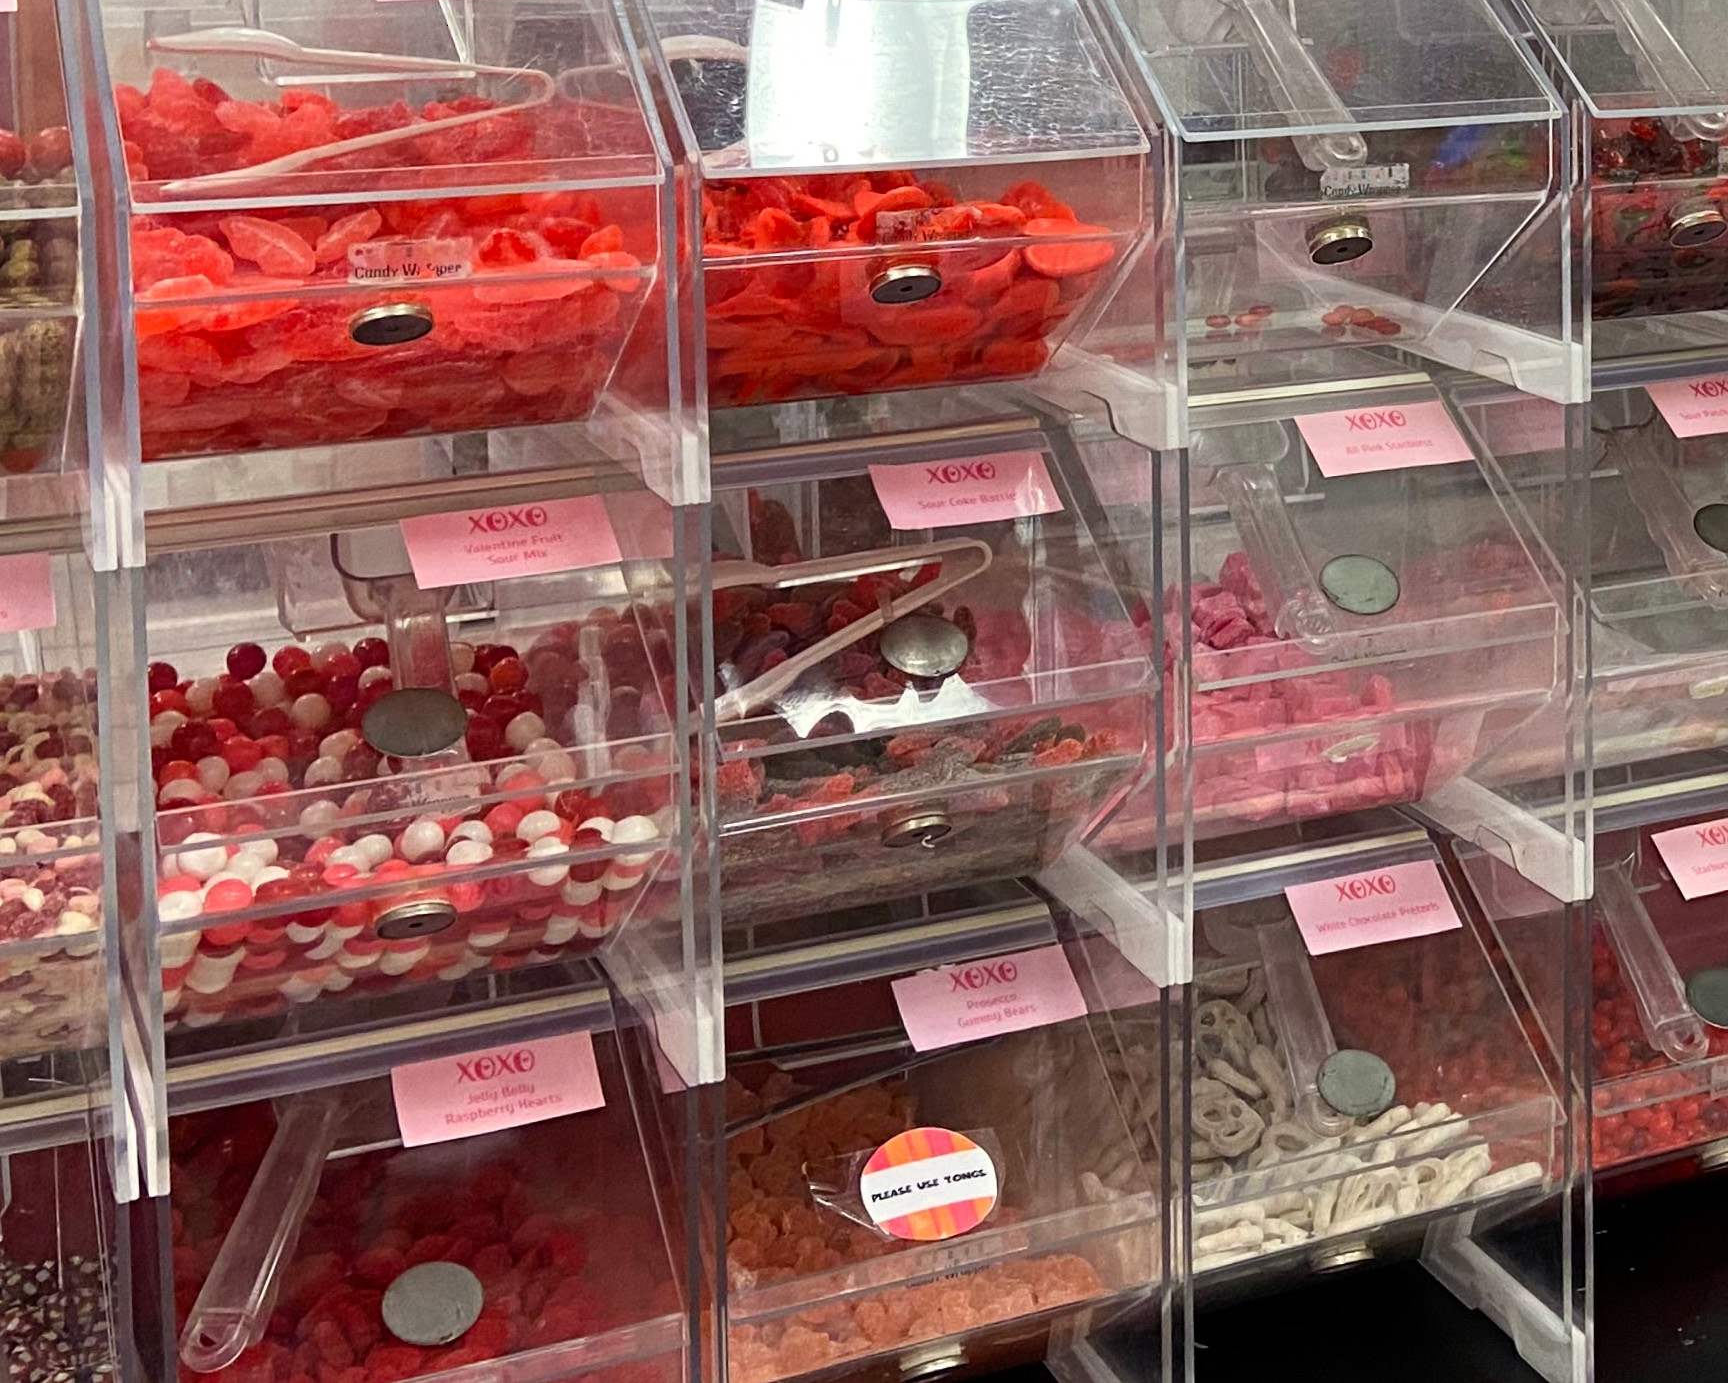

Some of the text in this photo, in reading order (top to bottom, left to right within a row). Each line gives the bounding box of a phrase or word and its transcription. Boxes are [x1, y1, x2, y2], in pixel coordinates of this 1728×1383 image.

[918, 495, 978, 510] Sour Coke
[464, 532, 565, 556] Valentine Fruit
[487, 549, 548, 566] Sour Mix
[1315, 901, 1441, 934] White Chocolate Pretzels
[966, 992, 1018, 1012] Prosecco
[957, 1004, 1037, 1030] Gummy Bears
[467, 1082, 536, 1106] Jelly Belly
[444, 1093, 563, 1126] Raspberry Hearts
[871, 1169, 988, 1203] PLEASE USE TONGS
